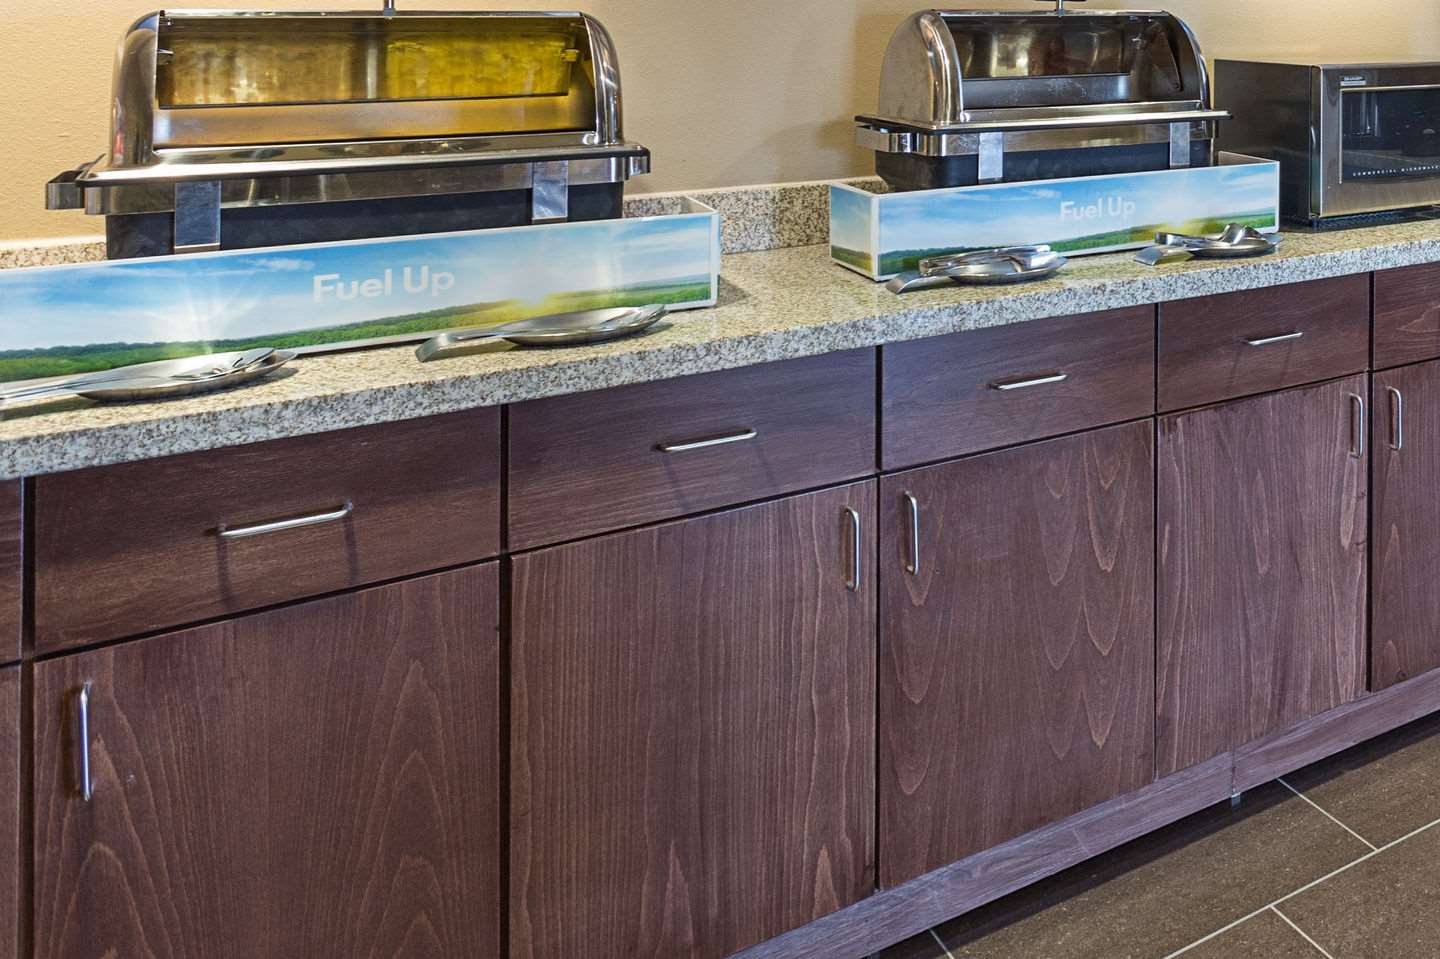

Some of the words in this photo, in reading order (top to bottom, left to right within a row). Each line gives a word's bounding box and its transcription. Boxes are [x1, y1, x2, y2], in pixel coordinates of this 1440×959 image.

[1060, 197, 1103, 222] Fuel
[1107, 195, 1136, 221] Up
[313, 268, 393, 303] Fuel
[403, 265, 455, 297] Up
